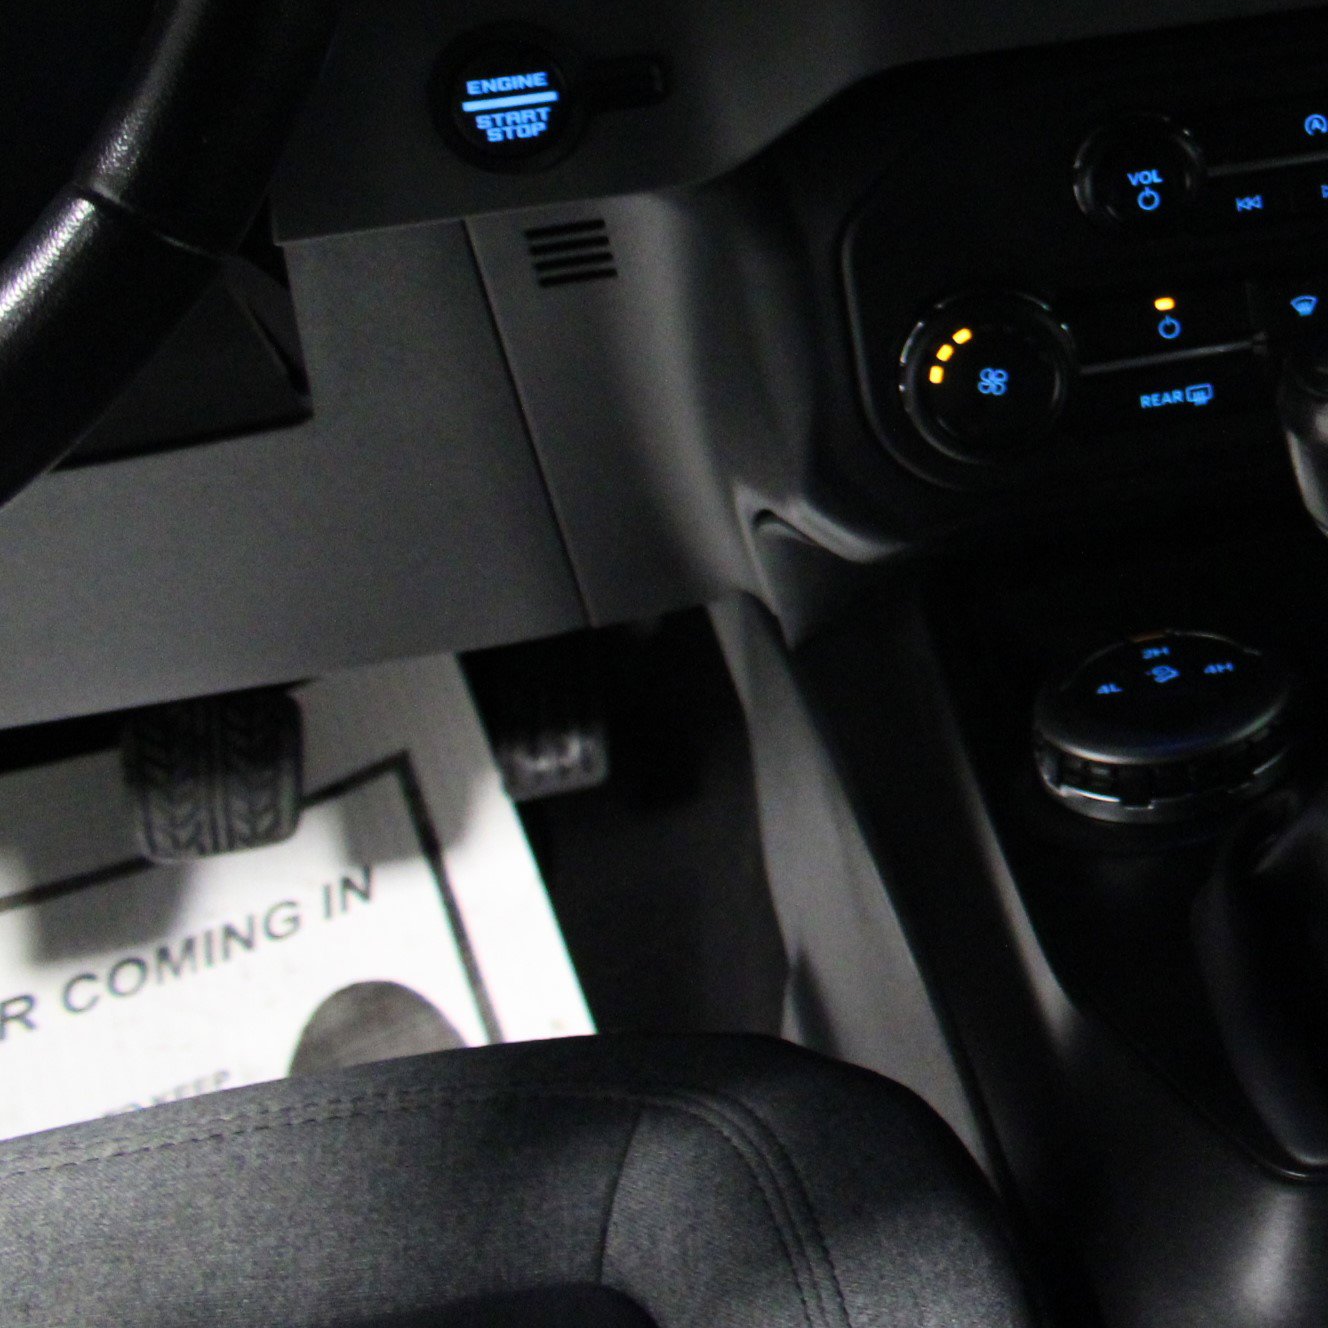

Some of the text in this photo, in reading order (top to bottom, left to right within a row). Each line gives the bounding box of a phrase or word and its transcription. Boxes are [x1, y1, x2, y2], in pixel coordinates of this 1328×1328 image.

[465, 71, 549, 96] ENGINE
[475, 106, 553, 131] START
[485, 122, 548, 144] STOP
[1126, 169, 1164, 187] VOL
[1140, 389, 1183, 408] REAR
[62, 900, 303, 1014] COMING
[321, 864, 376, 920] IN
